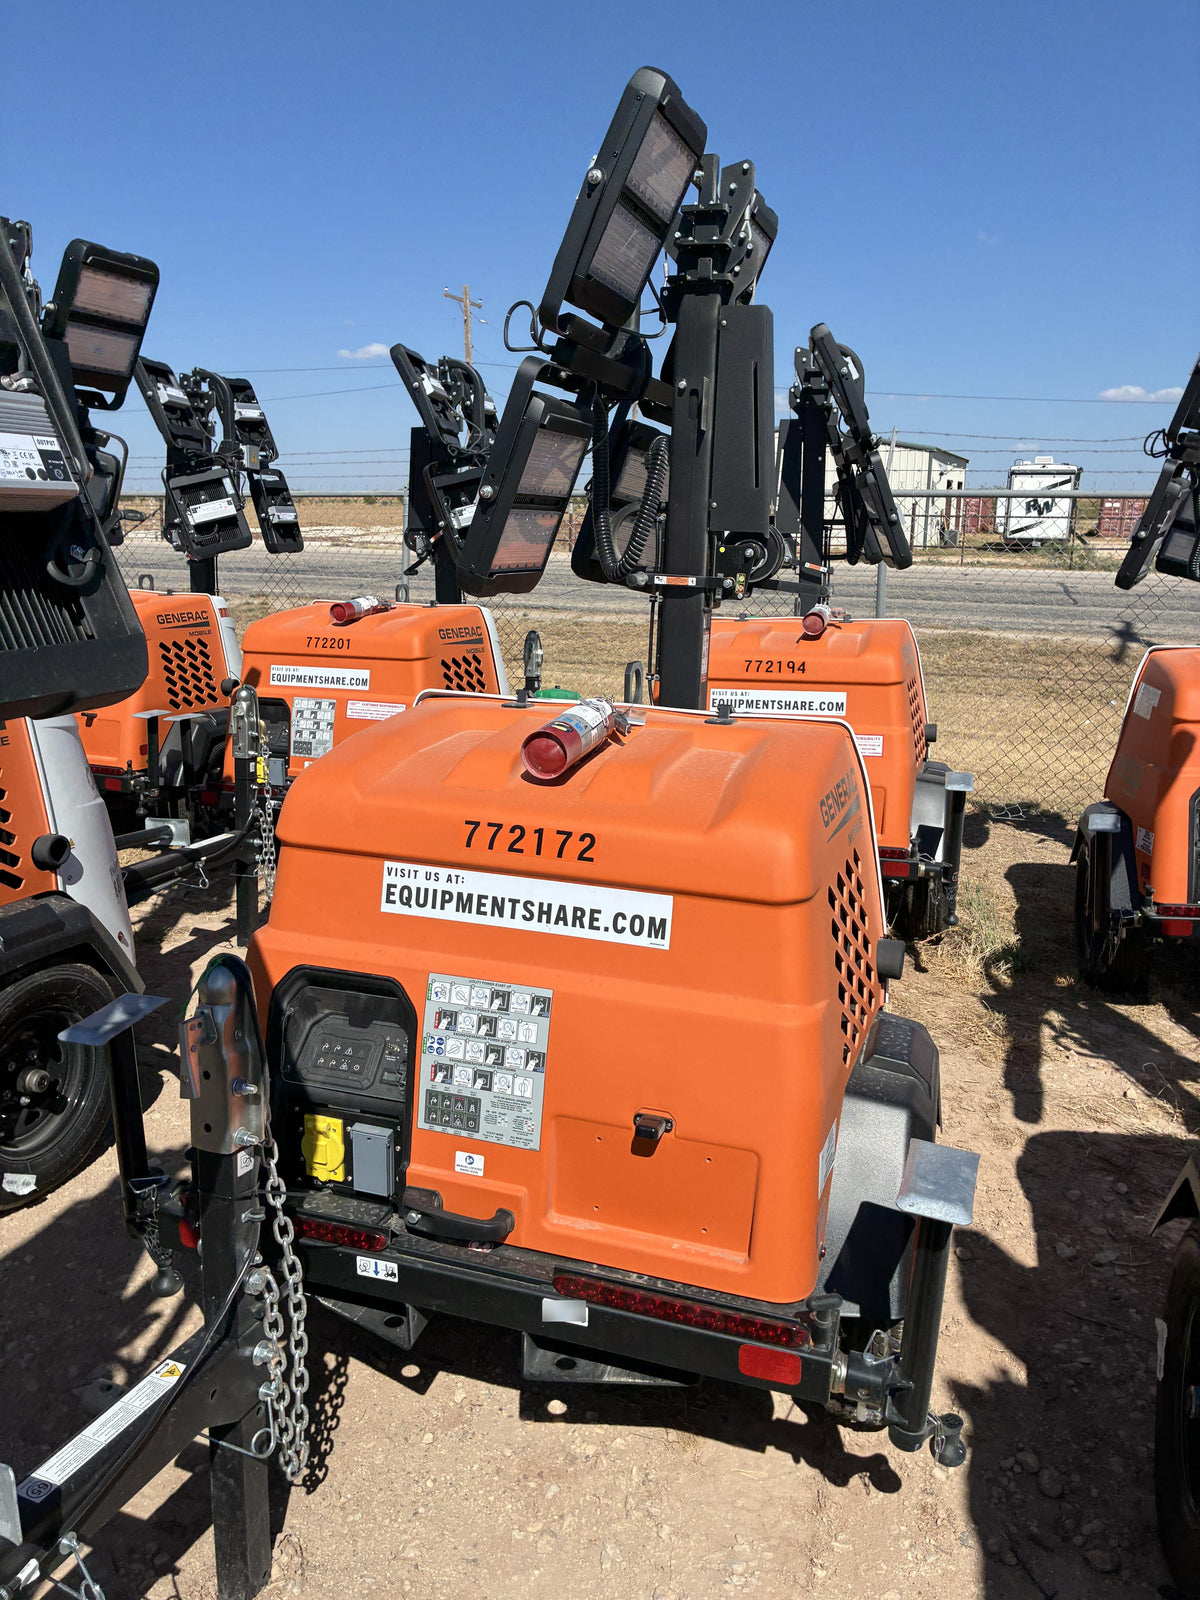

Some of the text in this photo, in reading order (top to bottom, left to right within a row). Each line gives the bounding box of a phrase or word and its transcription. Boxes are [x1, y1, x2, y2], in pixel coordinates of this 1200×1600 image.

[156, 610, 209, 625] GENERAC
[188, 629, 212, 637] MOBILE
[438, 626, 483, 640] GENERAC
[306, 636, 351, 650] 772201
[744, 660, 807, 674] 772194
[271, 673, 368, 687] EQUIPMENTSHARE.COM
[711, 698, 845, 712] EQUIPMENTSHARE.COM
[819, 766, 858, 829] GENERAC
[464, 820, 597, 862] 772172
[386, 866, 466, 885] VISIT US AT:
[385, 883, 668, 940] EQUIPMENTSHARE.COM
